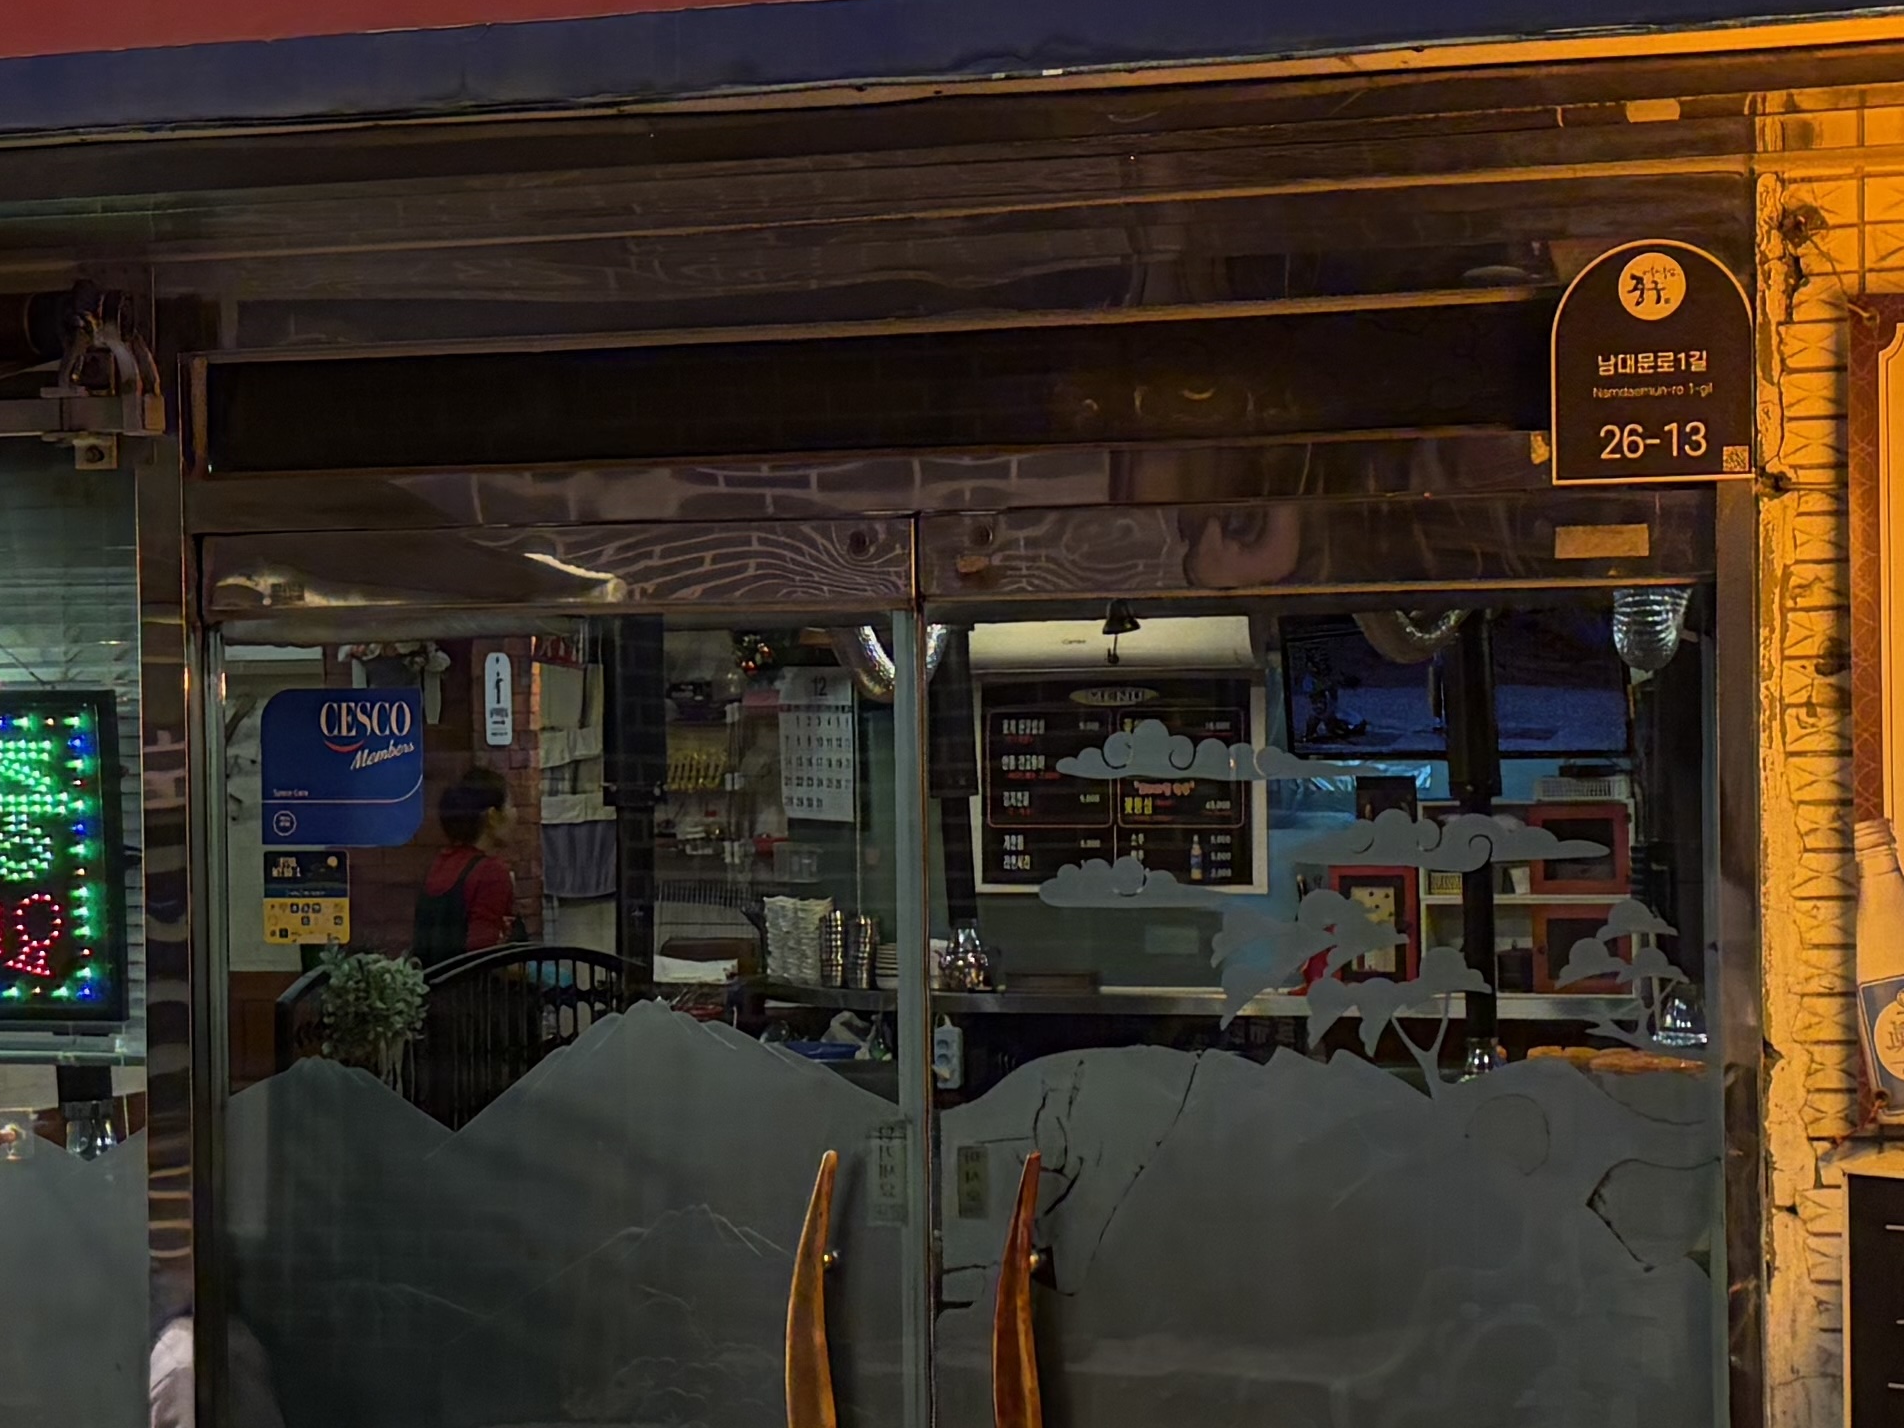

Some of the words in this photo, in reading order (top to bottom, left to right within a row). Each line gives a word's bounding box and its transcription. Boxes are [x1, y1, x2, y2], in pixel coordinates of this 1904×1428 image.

[1597, 350, 1708, 376] 남대문로1길
[1599, 422, 1707, 460] 26-13
[319, 700, 412, 737] CESCO
[349, 738, 415, 771] Members
